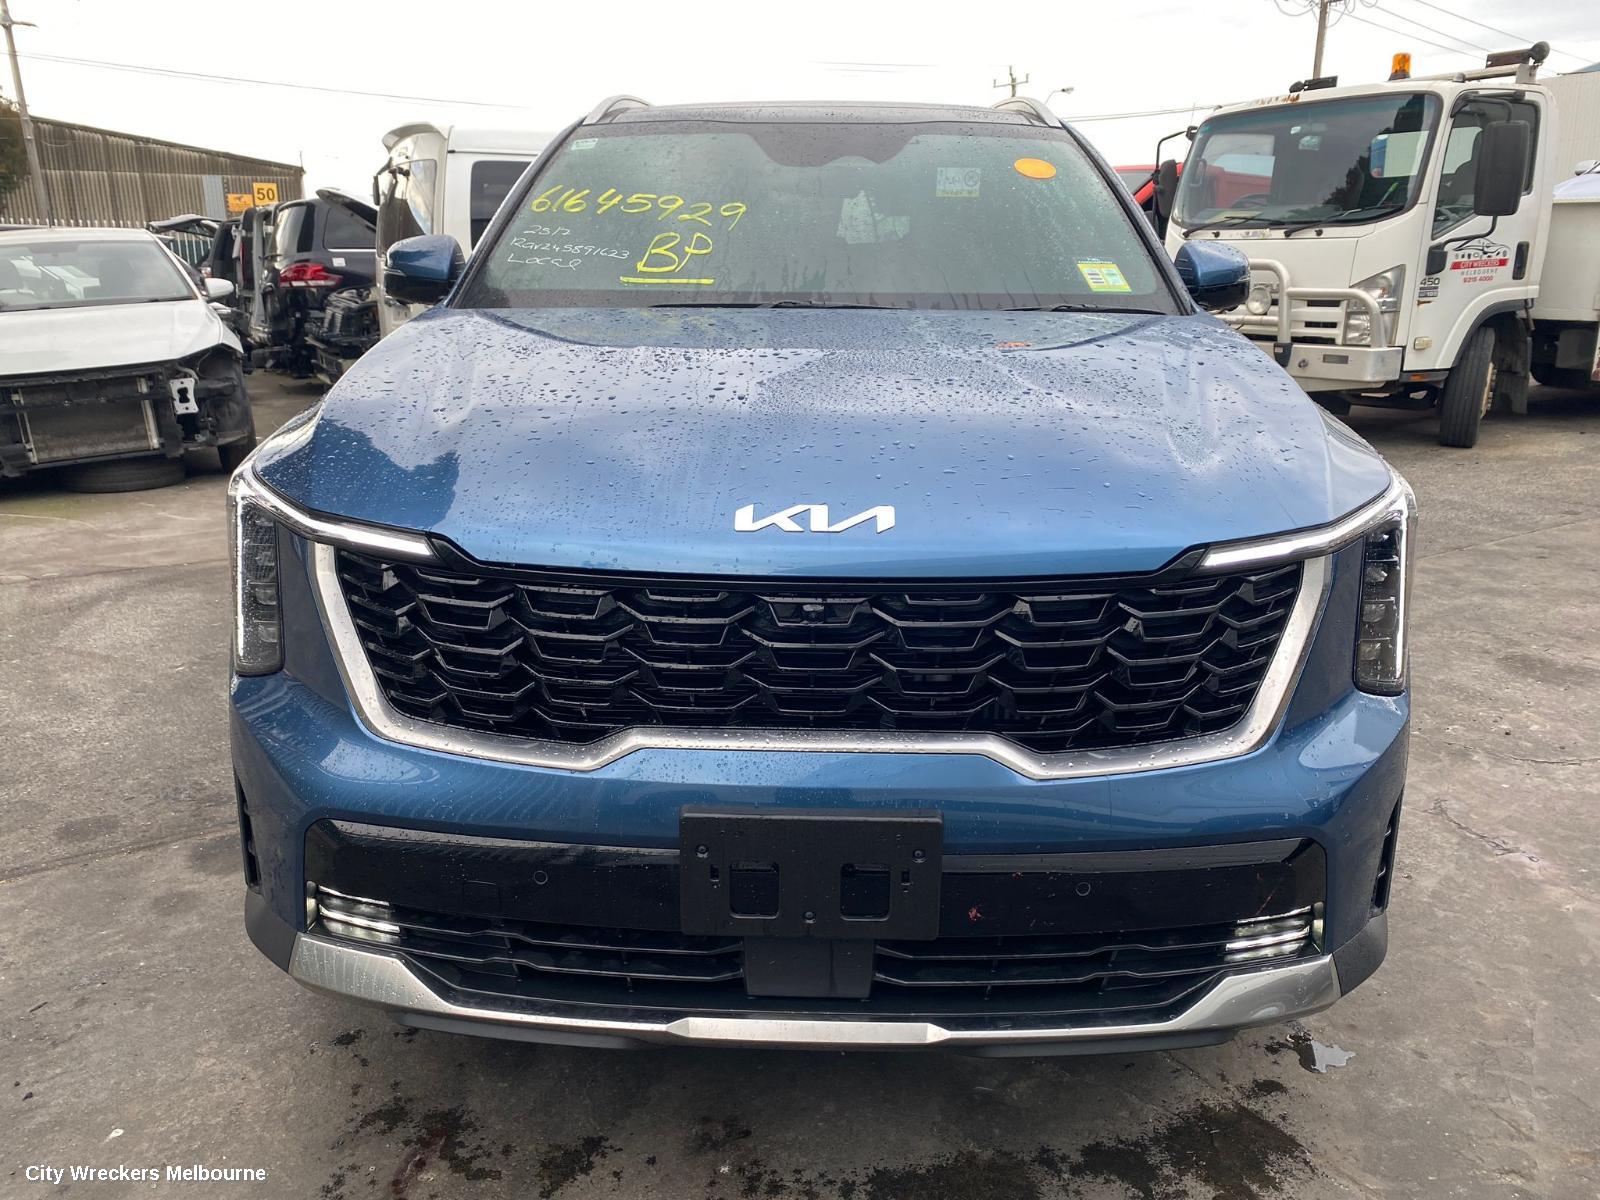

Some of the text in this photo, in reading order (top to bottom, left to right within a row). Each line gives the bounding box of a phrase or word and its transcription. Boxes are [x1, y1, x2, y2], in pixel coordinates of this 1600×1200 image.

[256, 187, 276, 201] 50
[636, 231, 713, 273] BP
[1461, 261, 1472, 269] CITY
[1460, 268, 1498, 276] MELBOURNE
[1420, 277, 1440, 286] 450
[734, 503, 896, 534] KIA
